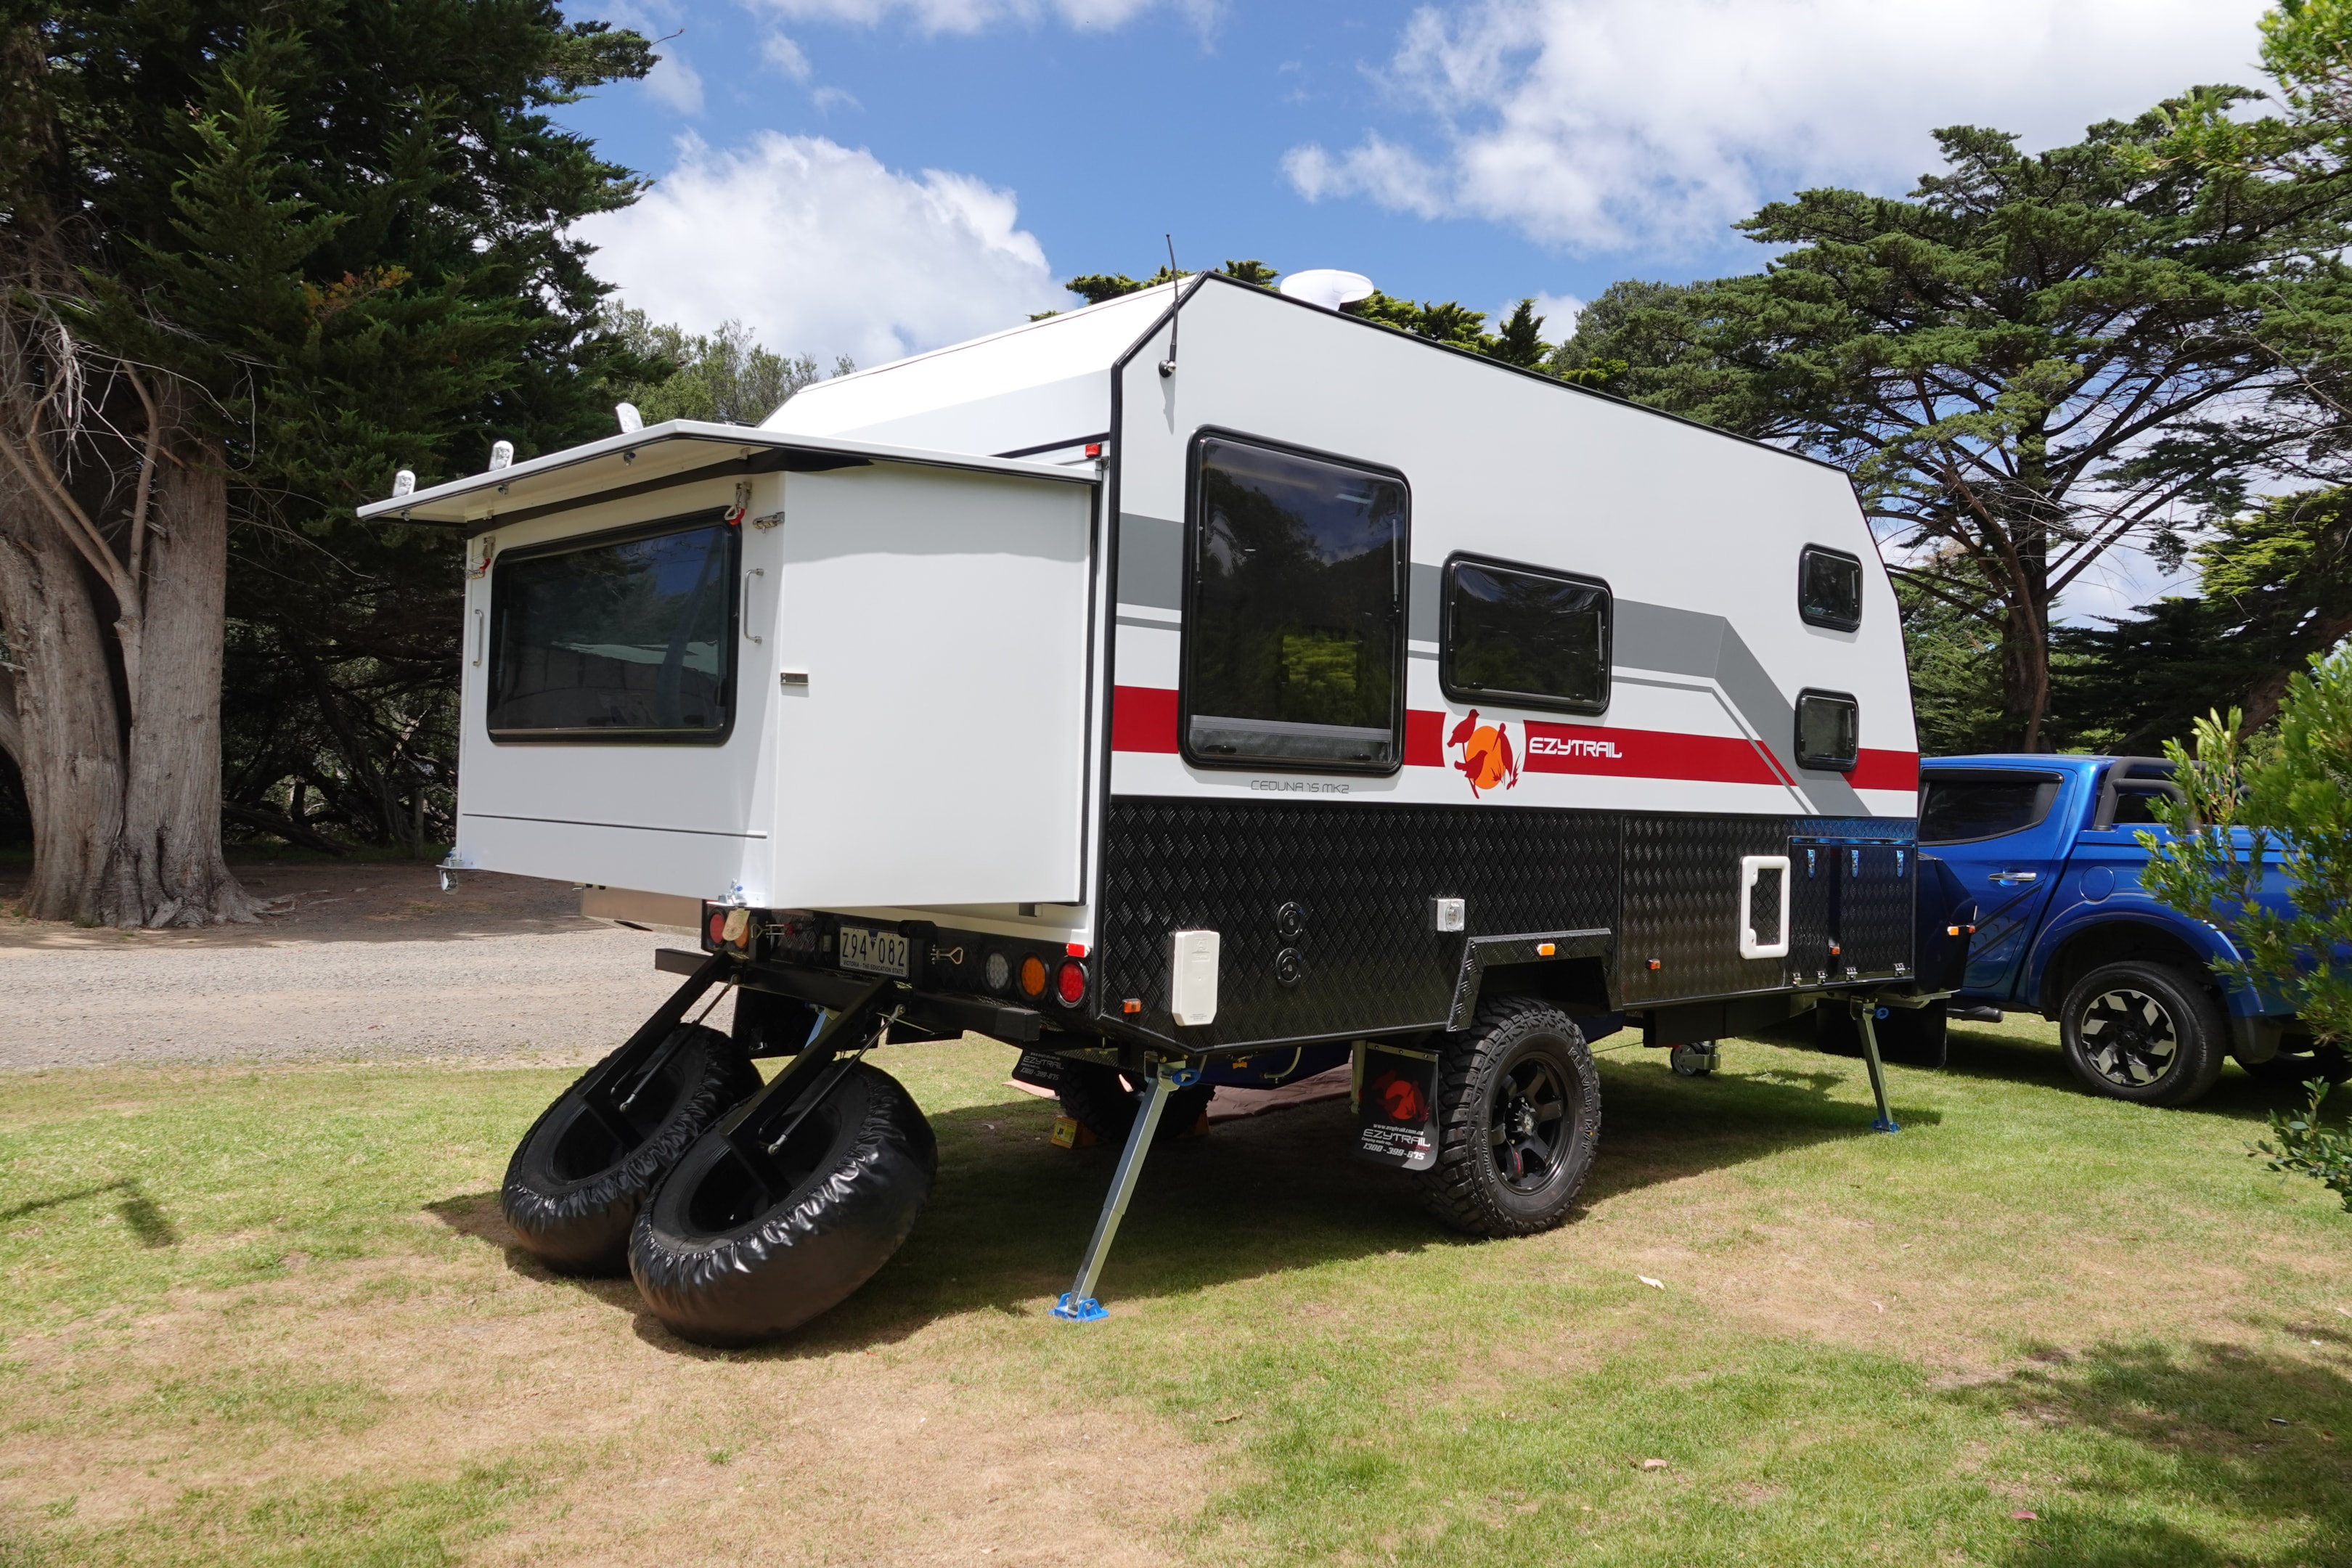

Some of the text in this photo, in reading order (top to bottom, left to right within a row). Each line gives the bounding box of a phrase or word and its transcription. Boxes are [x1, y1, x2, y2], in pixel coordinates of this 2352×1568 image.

[1529, 736, 1622, 759] EZYTRAIL
[1251, 780, 1304, 792] CEDUNA
[1322, 783, 1349, 794] MK2
[842, 932, 905, 967] Z94 082
[870, 964, 891, 973] EDUCATION
[1567, 1046, 1593, 1114] KLEVER
[1363, 1128, 1432, 1148] EZYTRAIL
